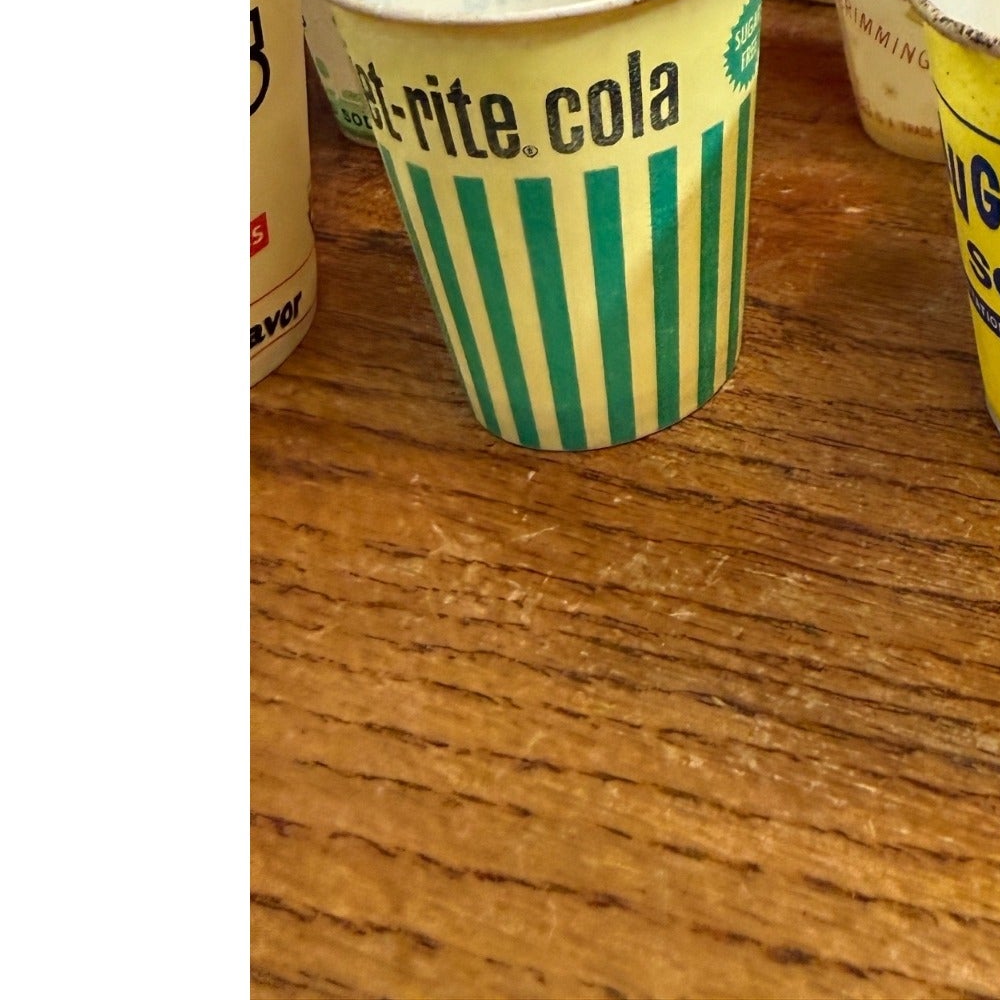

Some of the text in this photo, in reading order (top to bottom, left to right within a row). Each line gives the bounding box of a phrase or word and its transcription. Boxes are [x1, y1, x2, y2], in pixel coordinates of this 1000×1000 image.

[355, 61, 521, 160] et-rite
[545, 50, 680, 155] cola
[250, 291, 302, 350] avor
